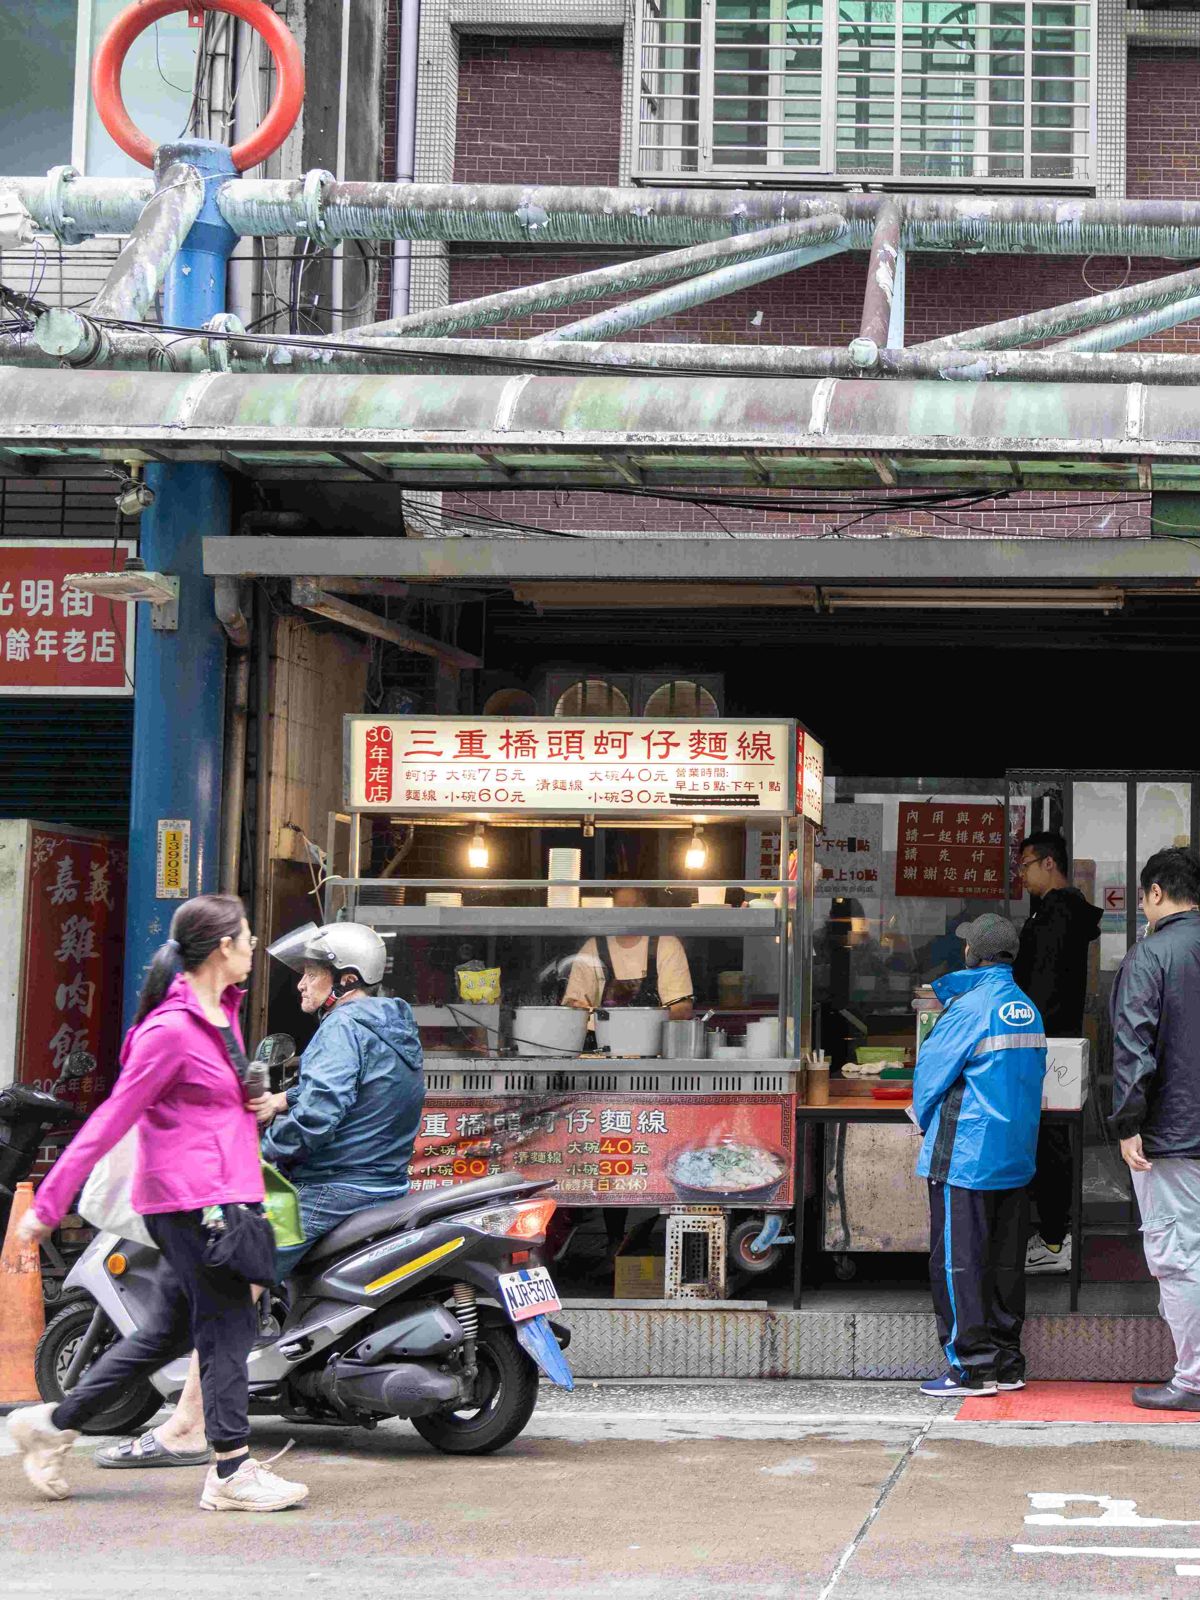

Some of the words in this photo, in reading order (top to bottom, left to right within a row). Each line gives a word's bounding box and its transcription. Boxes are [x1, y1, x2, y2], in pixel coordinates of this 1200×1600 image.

[0, 628, 115, 663] 餘年老店
[404, 729, 775, 761] 三重橋頭蚵仔麵線
[366, 727, 393, 802] 30年老店
[589, 768, 668, 782] 大碗40元
[405, 789, 437, 801] 麵線
[444, 788, 526, 802] 小碗60元
[588, 789, 668, 803] 小碗30元
[167, 833, 180, 887] 139038
[46, 855, 114, 911] 嘉義
[1002, 1002, 1032, 1020] Arai
[568, 1139, 649, 1155] 大碗40元
[566, 1160, 649, 1176] 小碗30元
